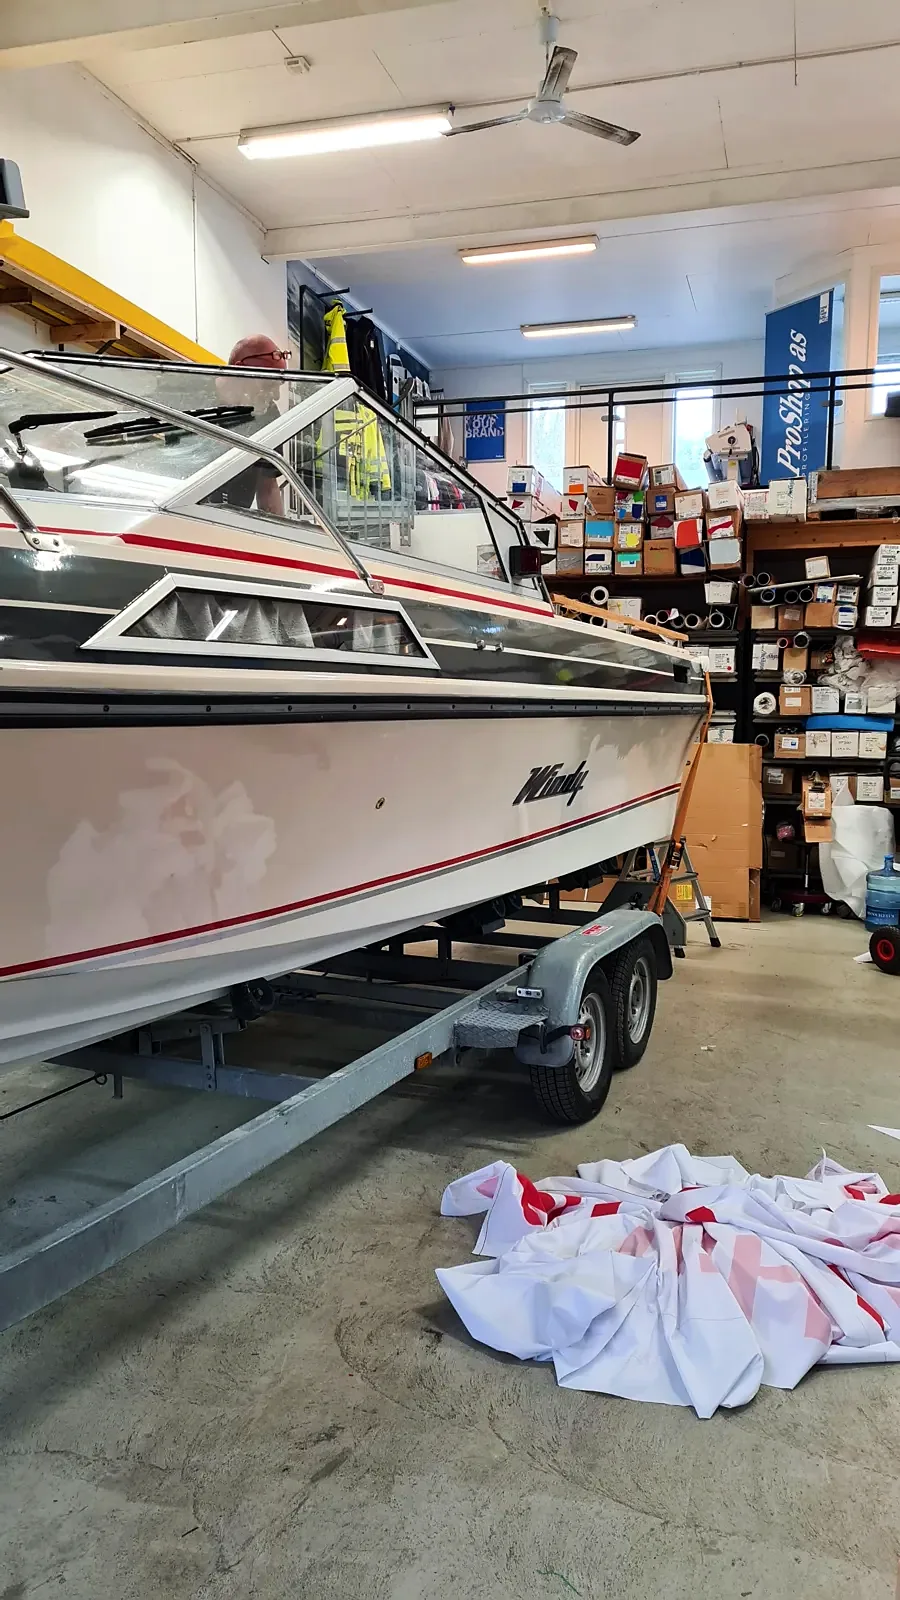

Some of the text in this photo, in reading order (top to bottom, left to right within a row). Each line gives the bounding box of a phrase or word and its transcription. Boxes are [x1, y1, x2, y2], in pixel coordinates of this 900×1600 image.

[789, 328, 807, 362] as
[777, 364, 811, 477] ProShop
[801, 391, 811, 477] PROFILERING
[512, 760, 590, 807] Windy
